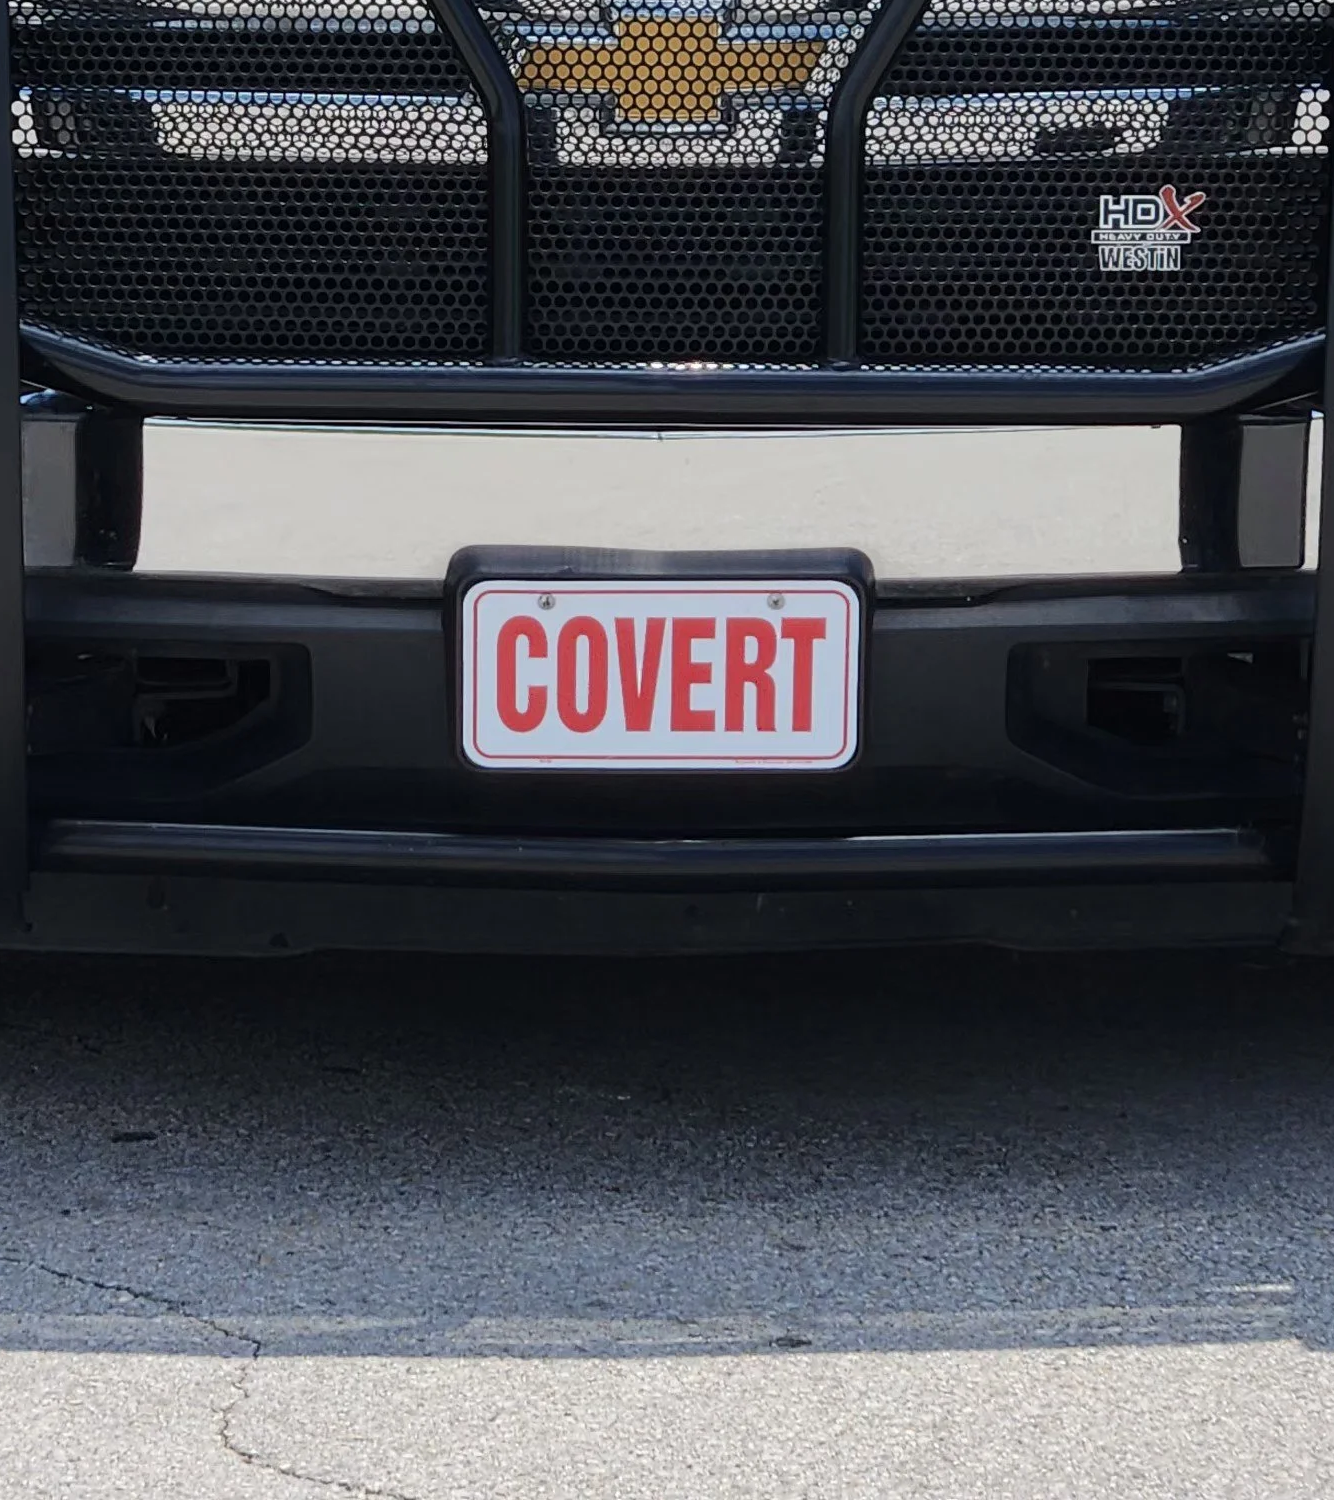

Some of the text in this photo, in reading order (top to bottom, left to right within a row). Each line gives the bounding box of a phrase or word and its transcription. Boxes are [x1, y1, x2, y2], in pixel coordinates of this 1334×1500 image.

[1099, 184, 1206, 232] HDX
[1099, 233, 1180, 241] HEAVY DUTY
[497, 615, 826, 733] COVERT
